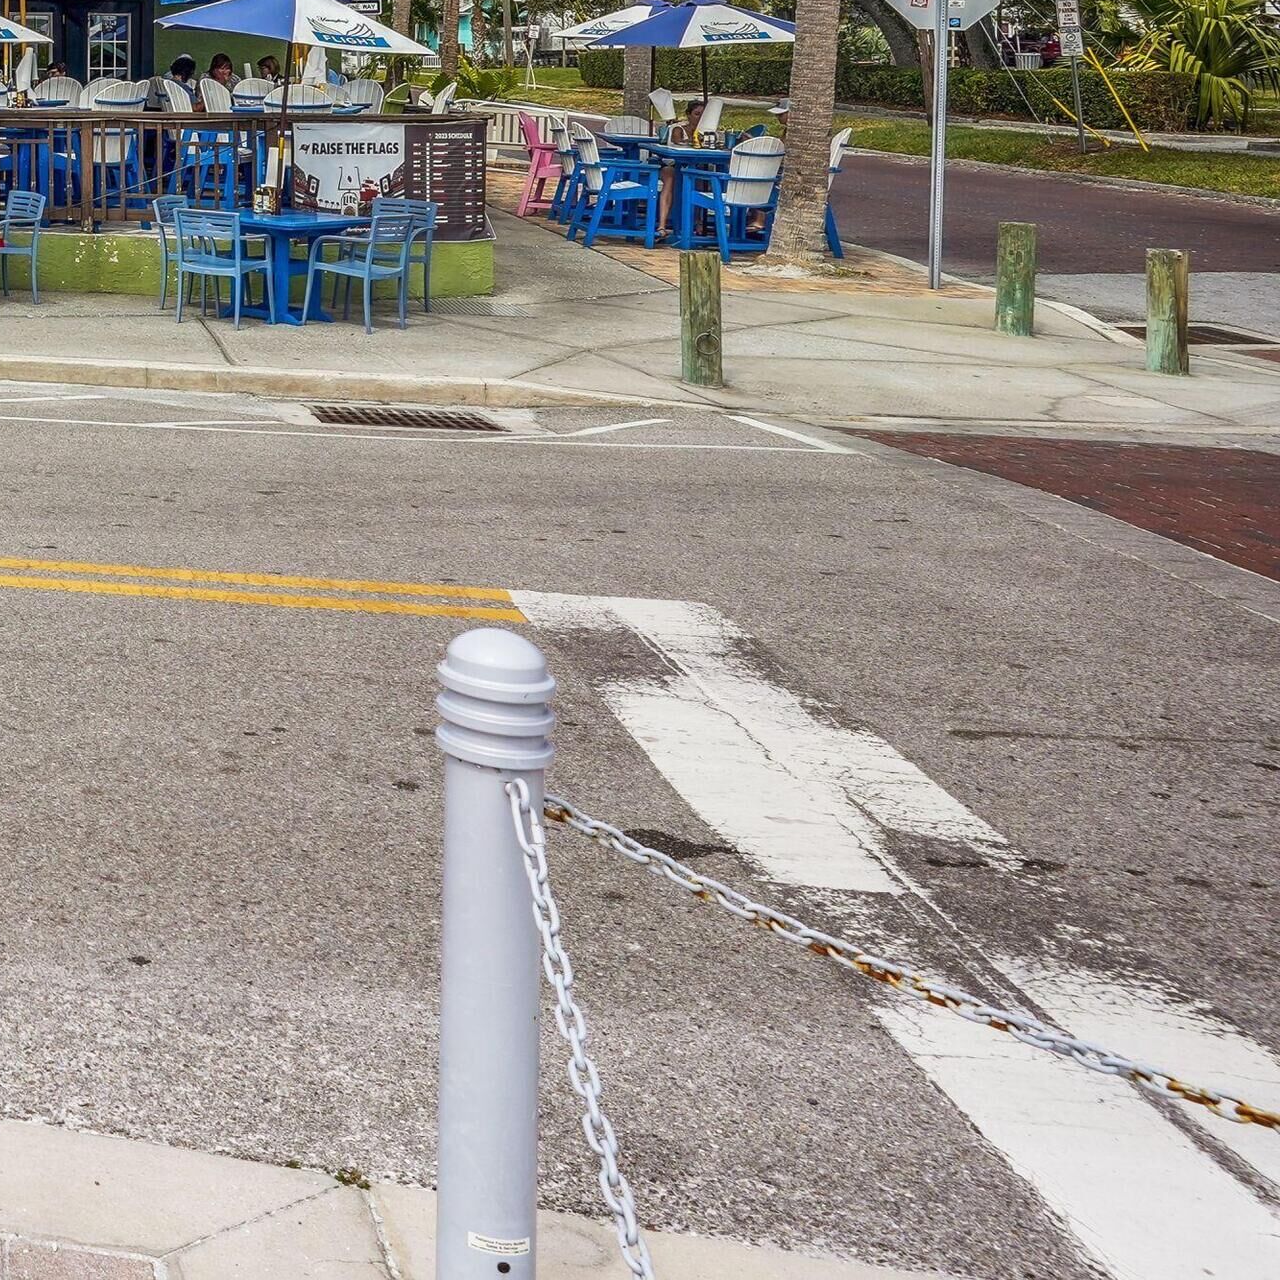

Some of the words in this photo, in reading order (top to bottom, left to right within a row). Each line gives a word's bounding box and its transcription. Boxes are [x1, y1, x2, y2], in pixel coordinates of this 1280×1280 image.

[322, 34, 377, 46] FLIGHT
[311, 142, 343, 155] RAISE
[345, 142, 366, 155] THE
[367, 142, 399, 155] FLAGS
